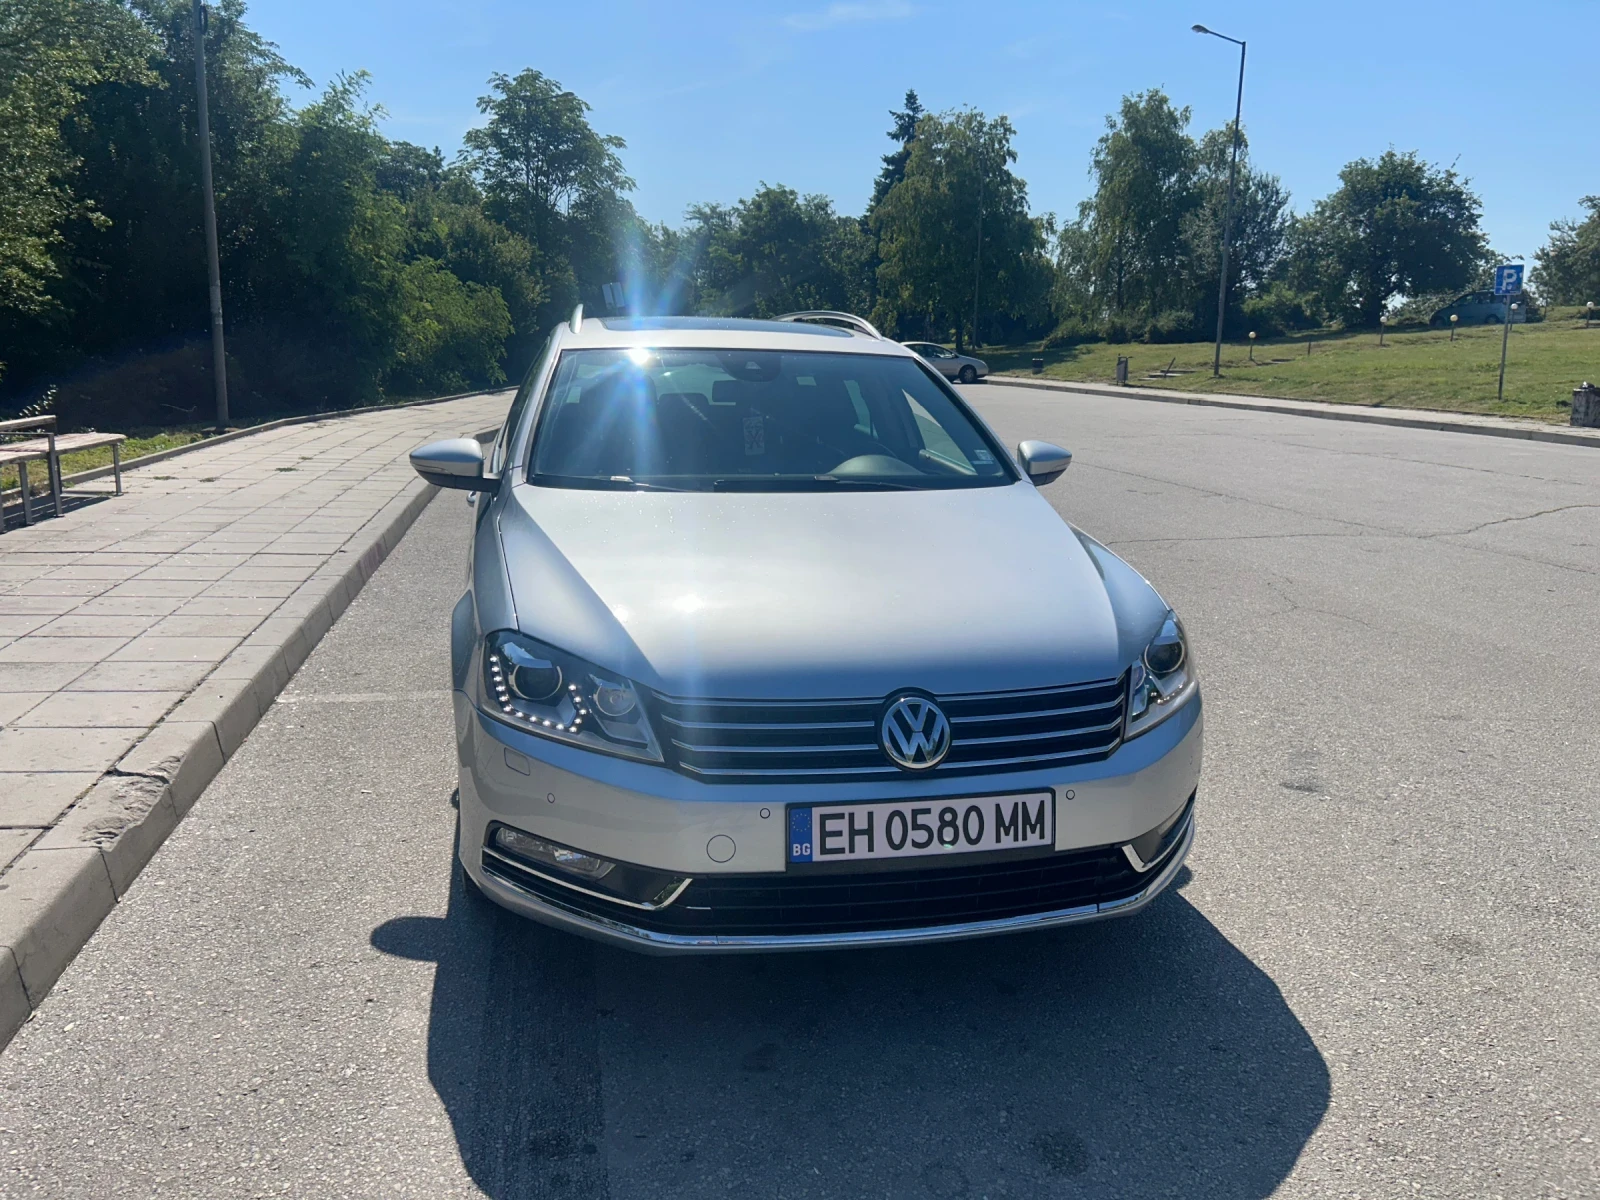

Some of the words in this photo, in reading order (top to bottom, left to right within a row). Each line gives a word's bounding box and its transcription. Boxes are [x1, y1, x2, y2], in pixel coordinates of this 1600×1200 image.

[1502, 269, 1517, 290] P
[882, 697, 950, 768] VW
[819, 811, 875, 855] EH
[885, 805, 985, 850] 0580
[995, 800, 1045, 843] MM
[792, 843, 811, 856] BG
